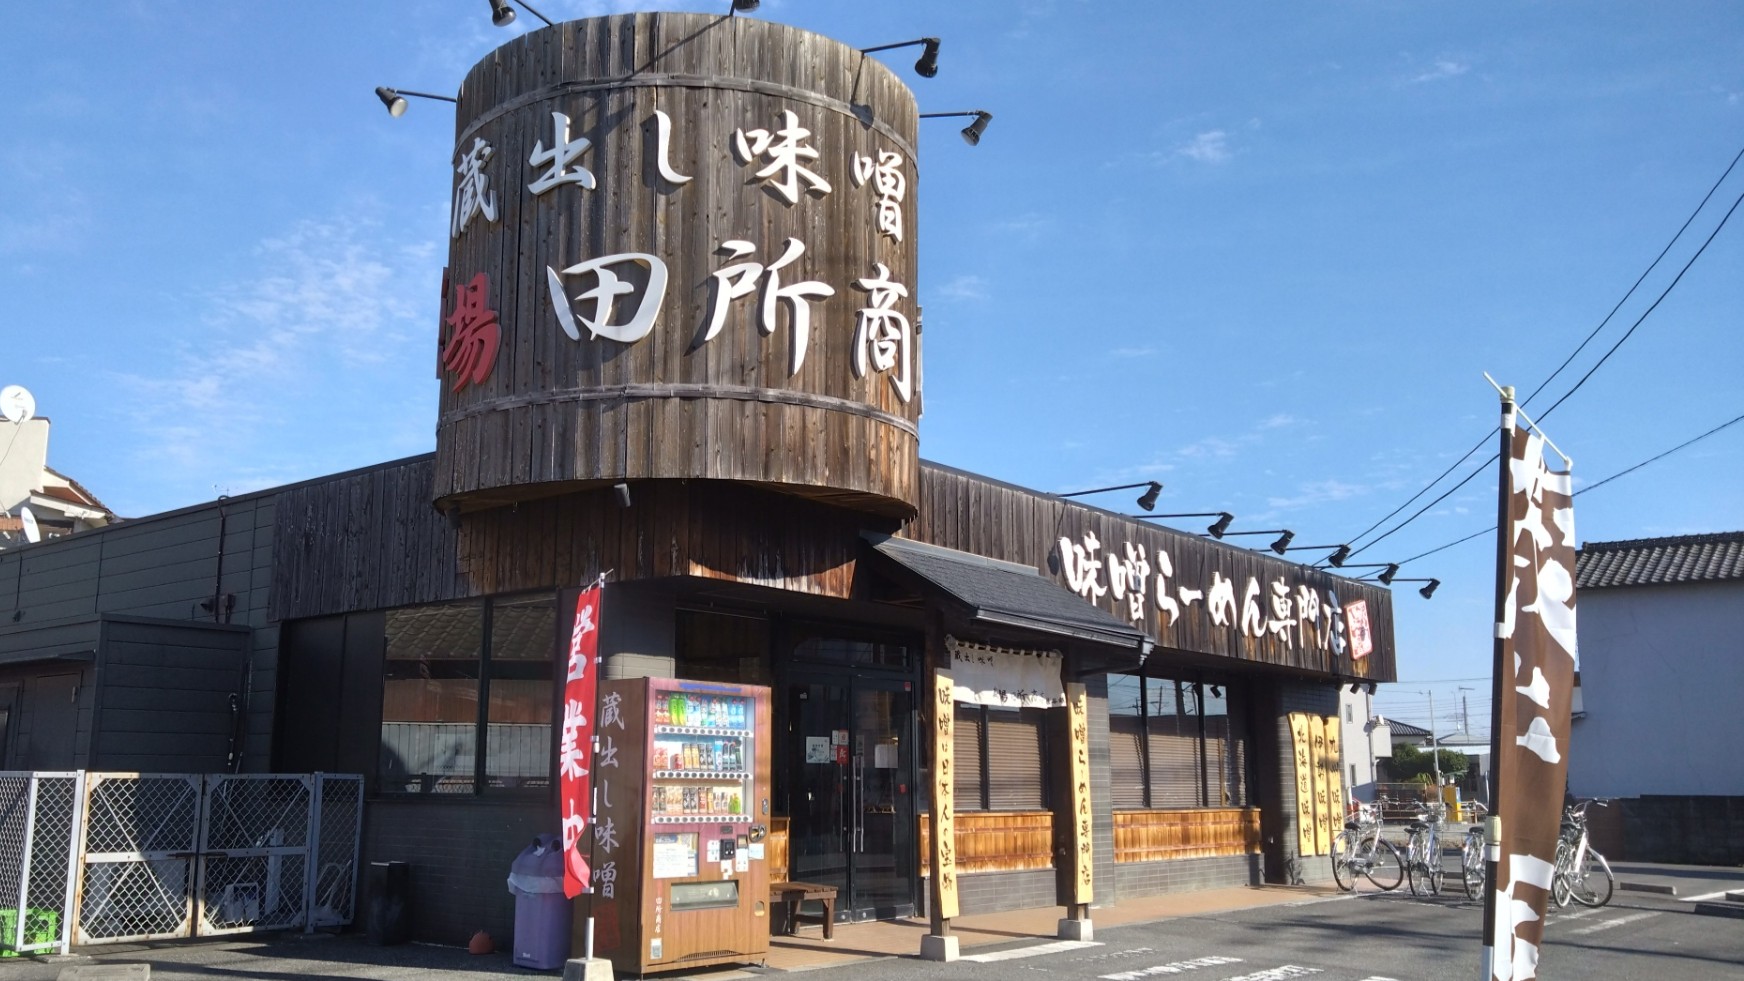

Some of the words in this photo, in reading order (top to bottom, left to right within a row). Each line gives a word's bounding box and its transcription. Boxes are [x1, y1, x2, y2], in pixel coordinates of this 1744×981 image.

[452, 109, 906, 243] 蔵出し味噌
[1058, 530, 1347, 657] 味噌らーめん専門店
[593, 691, 625, 899] 蔵出し味噌
